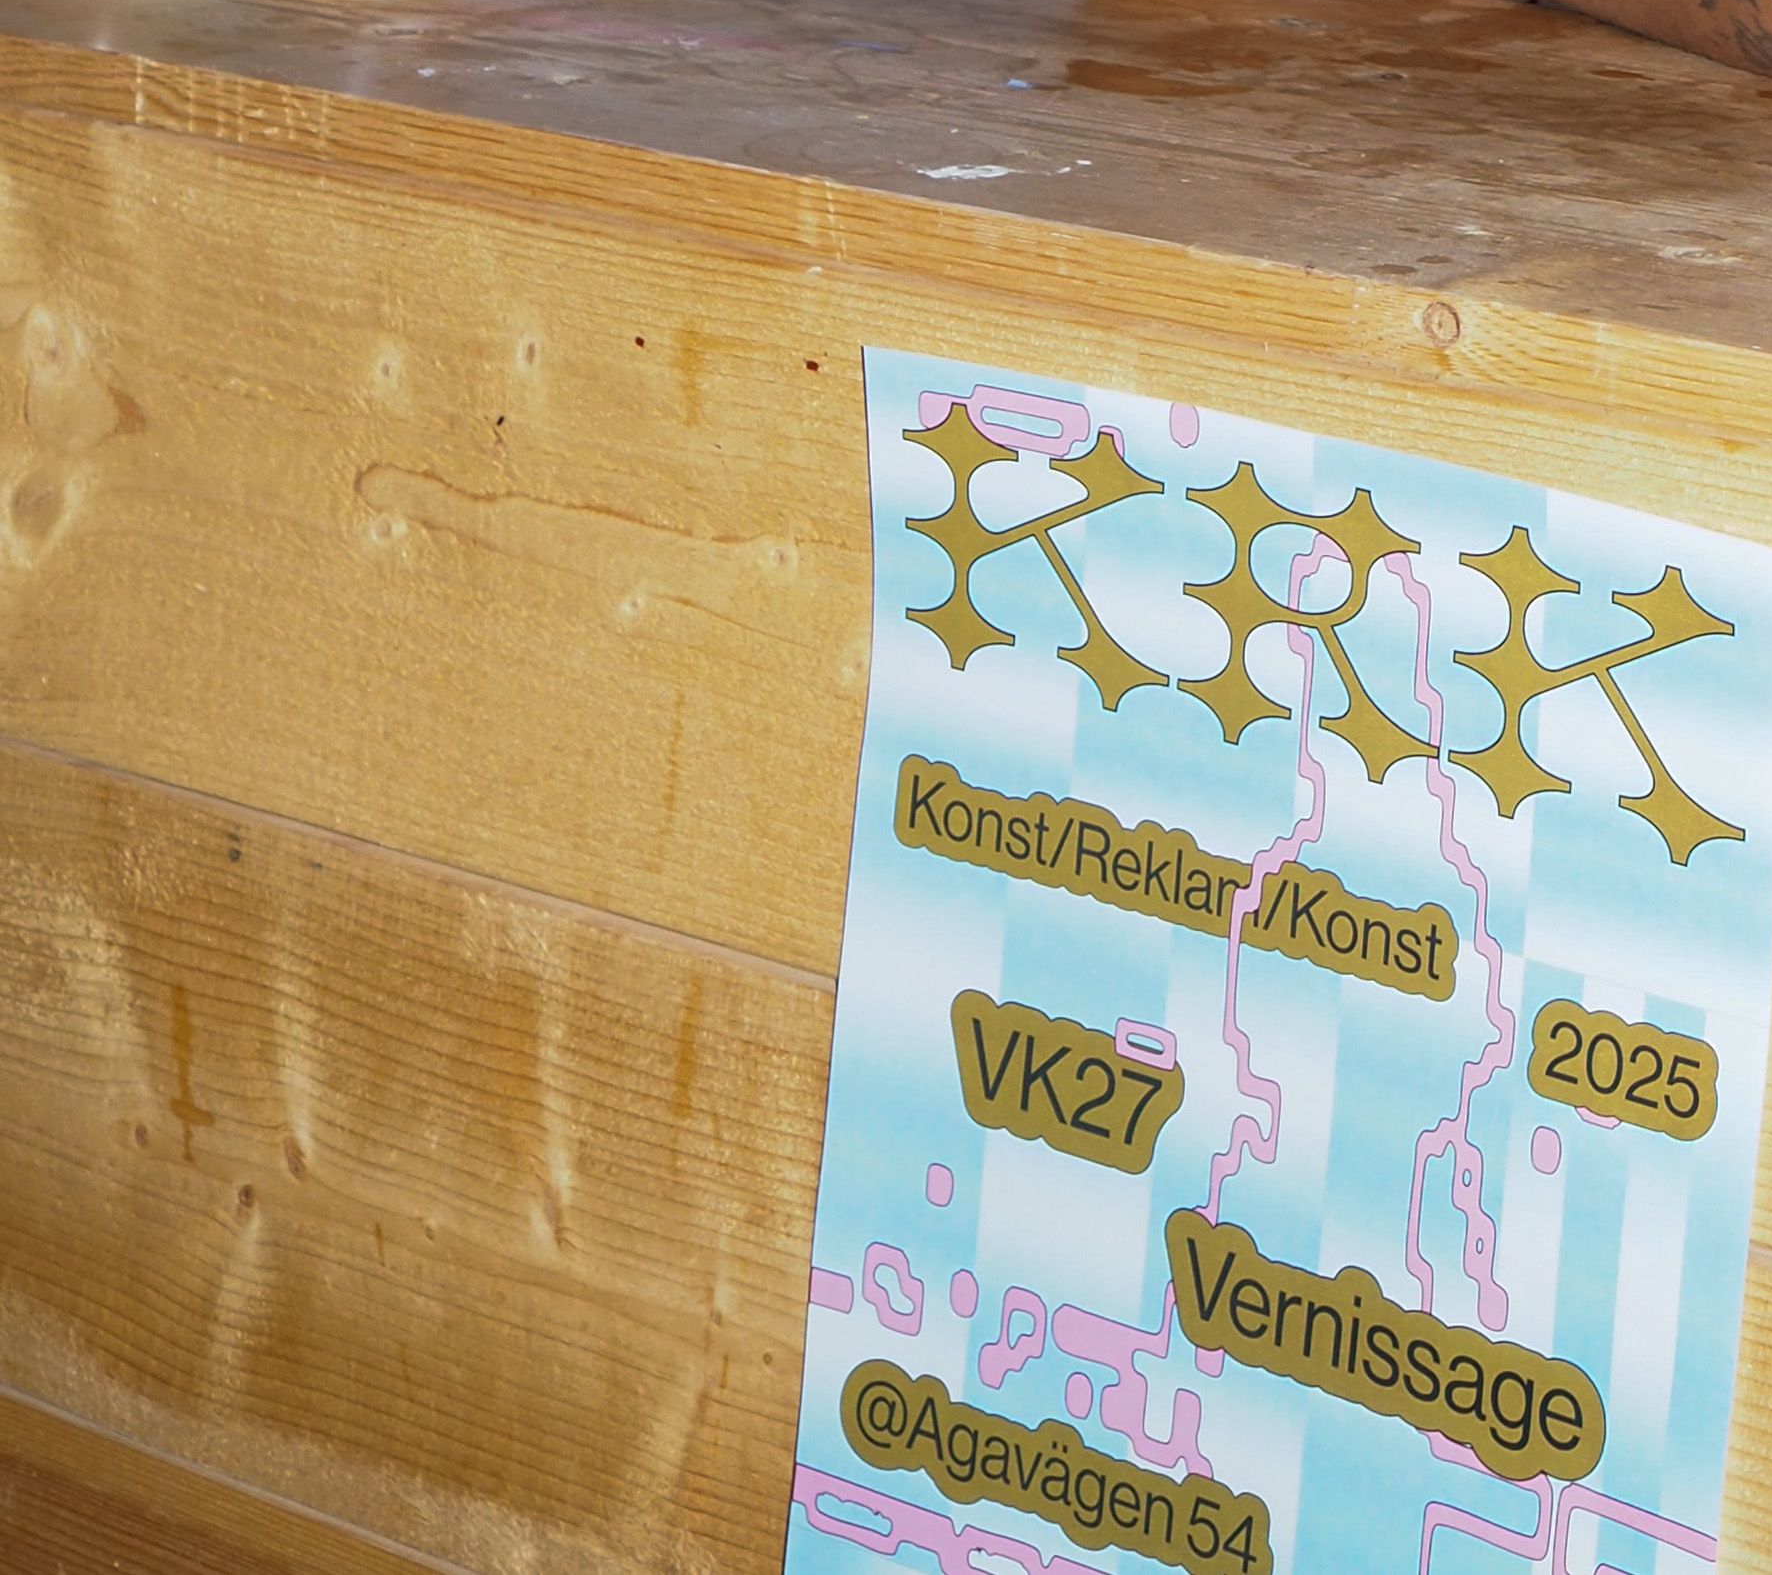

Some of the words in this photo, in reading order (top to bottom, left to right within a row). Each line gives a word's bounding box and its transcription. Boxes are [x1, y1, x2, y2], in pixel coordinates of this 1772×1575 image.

[904, 404, 1744, 865] KRK
[972, 1018, 1163, 1146] VK27
[1545, 1021, 1701, 1119] 2025
[1187, 1238, 1585, 1451] Vernissage
[856, 1380, 1174, 1544] @Agavägen
[1186, 1498, 1259, 1574] 54
